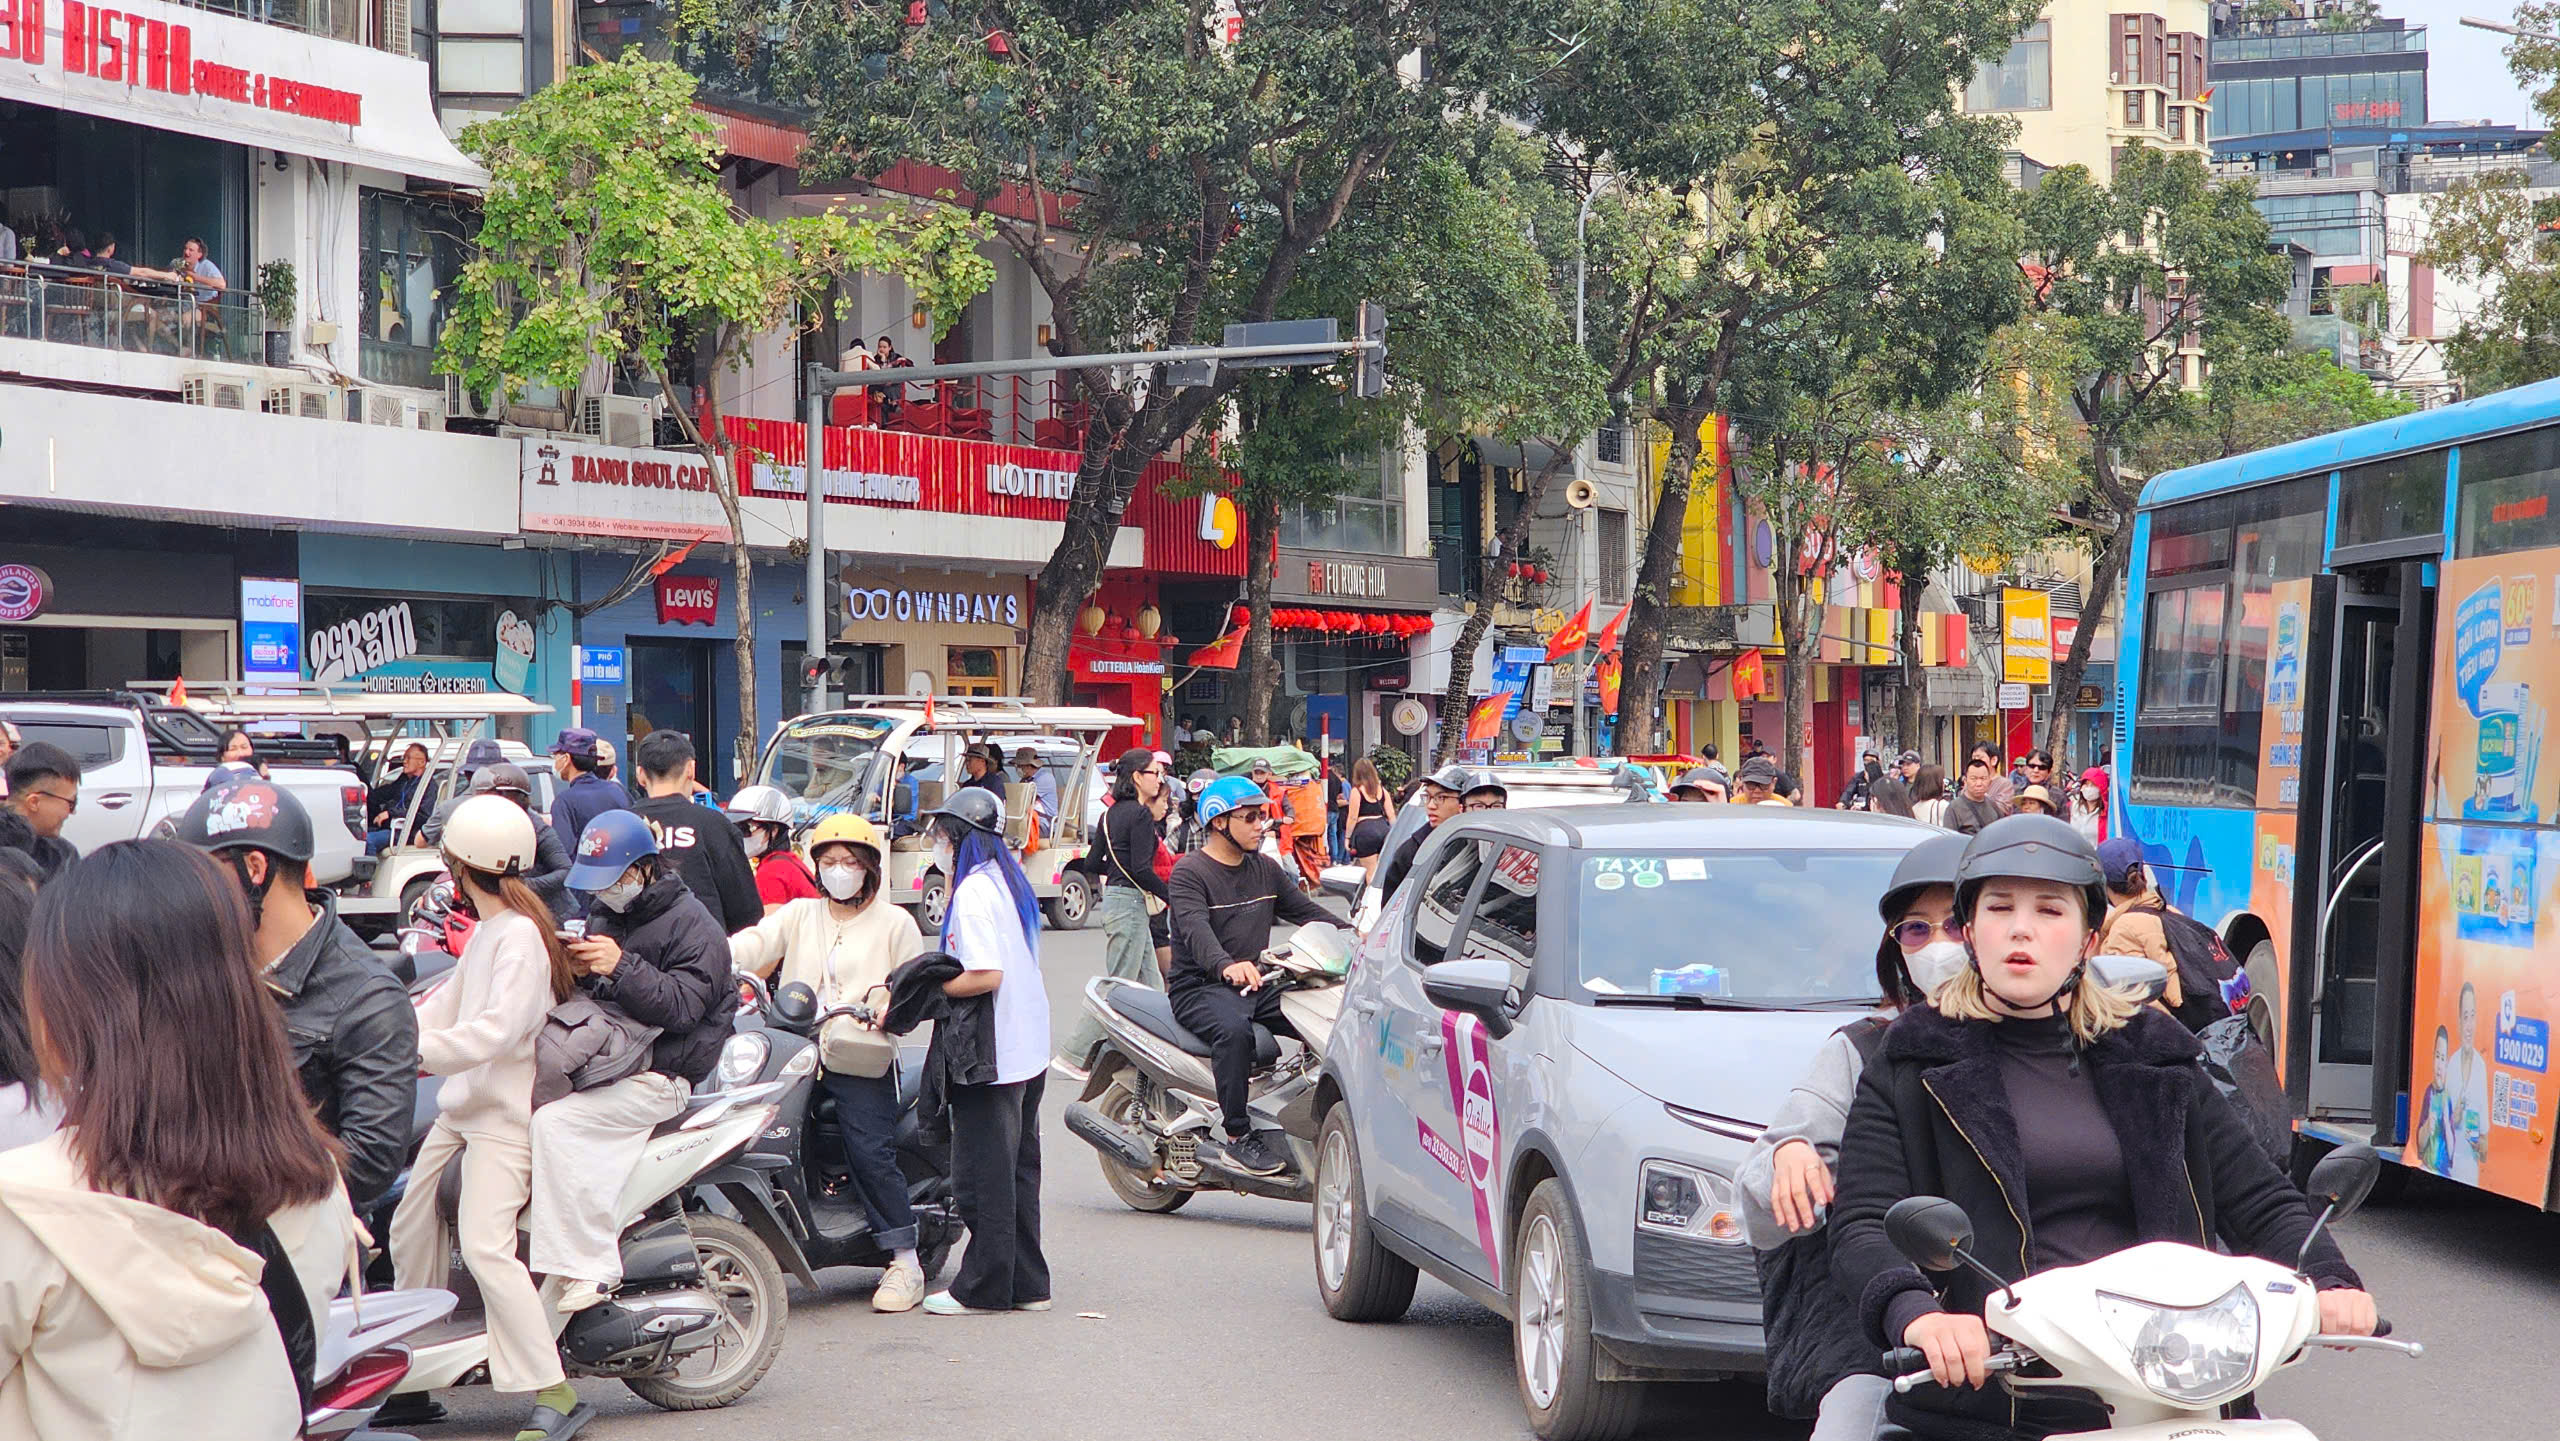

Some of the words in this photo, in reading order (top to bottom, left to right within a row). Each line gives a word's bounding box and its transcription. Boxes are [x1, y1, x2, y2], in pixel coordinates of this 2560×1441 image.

[63, 0, 191, 96] BISTRO
[193, 59, 251, 105] COFFEE
[253, 73, 268, 108] &
[269, 76, 363, 127] RESTAURANT
[571, 455, 629, 486] HANOI
[631, 460, 676, 490] SOUL
[0, 566, 39, 590] HLANDS
[1326, 562, 1339, 594] FU
[1341, 564, 1365, 596] RONG
[1368, 566, 1387, 597] HUA
[0, 602, 33, 617] OFFEE
[247, 593, 294, 608] mobifone
[895, 590, 1018, 625] OWNDAYS
[1091, 660, 1134, 673] LOTTERIA
[365, 675, 422, 693] HOMEMADE
[437, 677, 453, 693] ICE
[453, 677, 487, 693] CREAM
[1595, 857, 1658, 873] TAXI
[2499, 1037, 2521, 1063] 1900
[2521, 1041, 2545, 1067] 0229
[2167, 1428, 2227, 1441] HONDA
